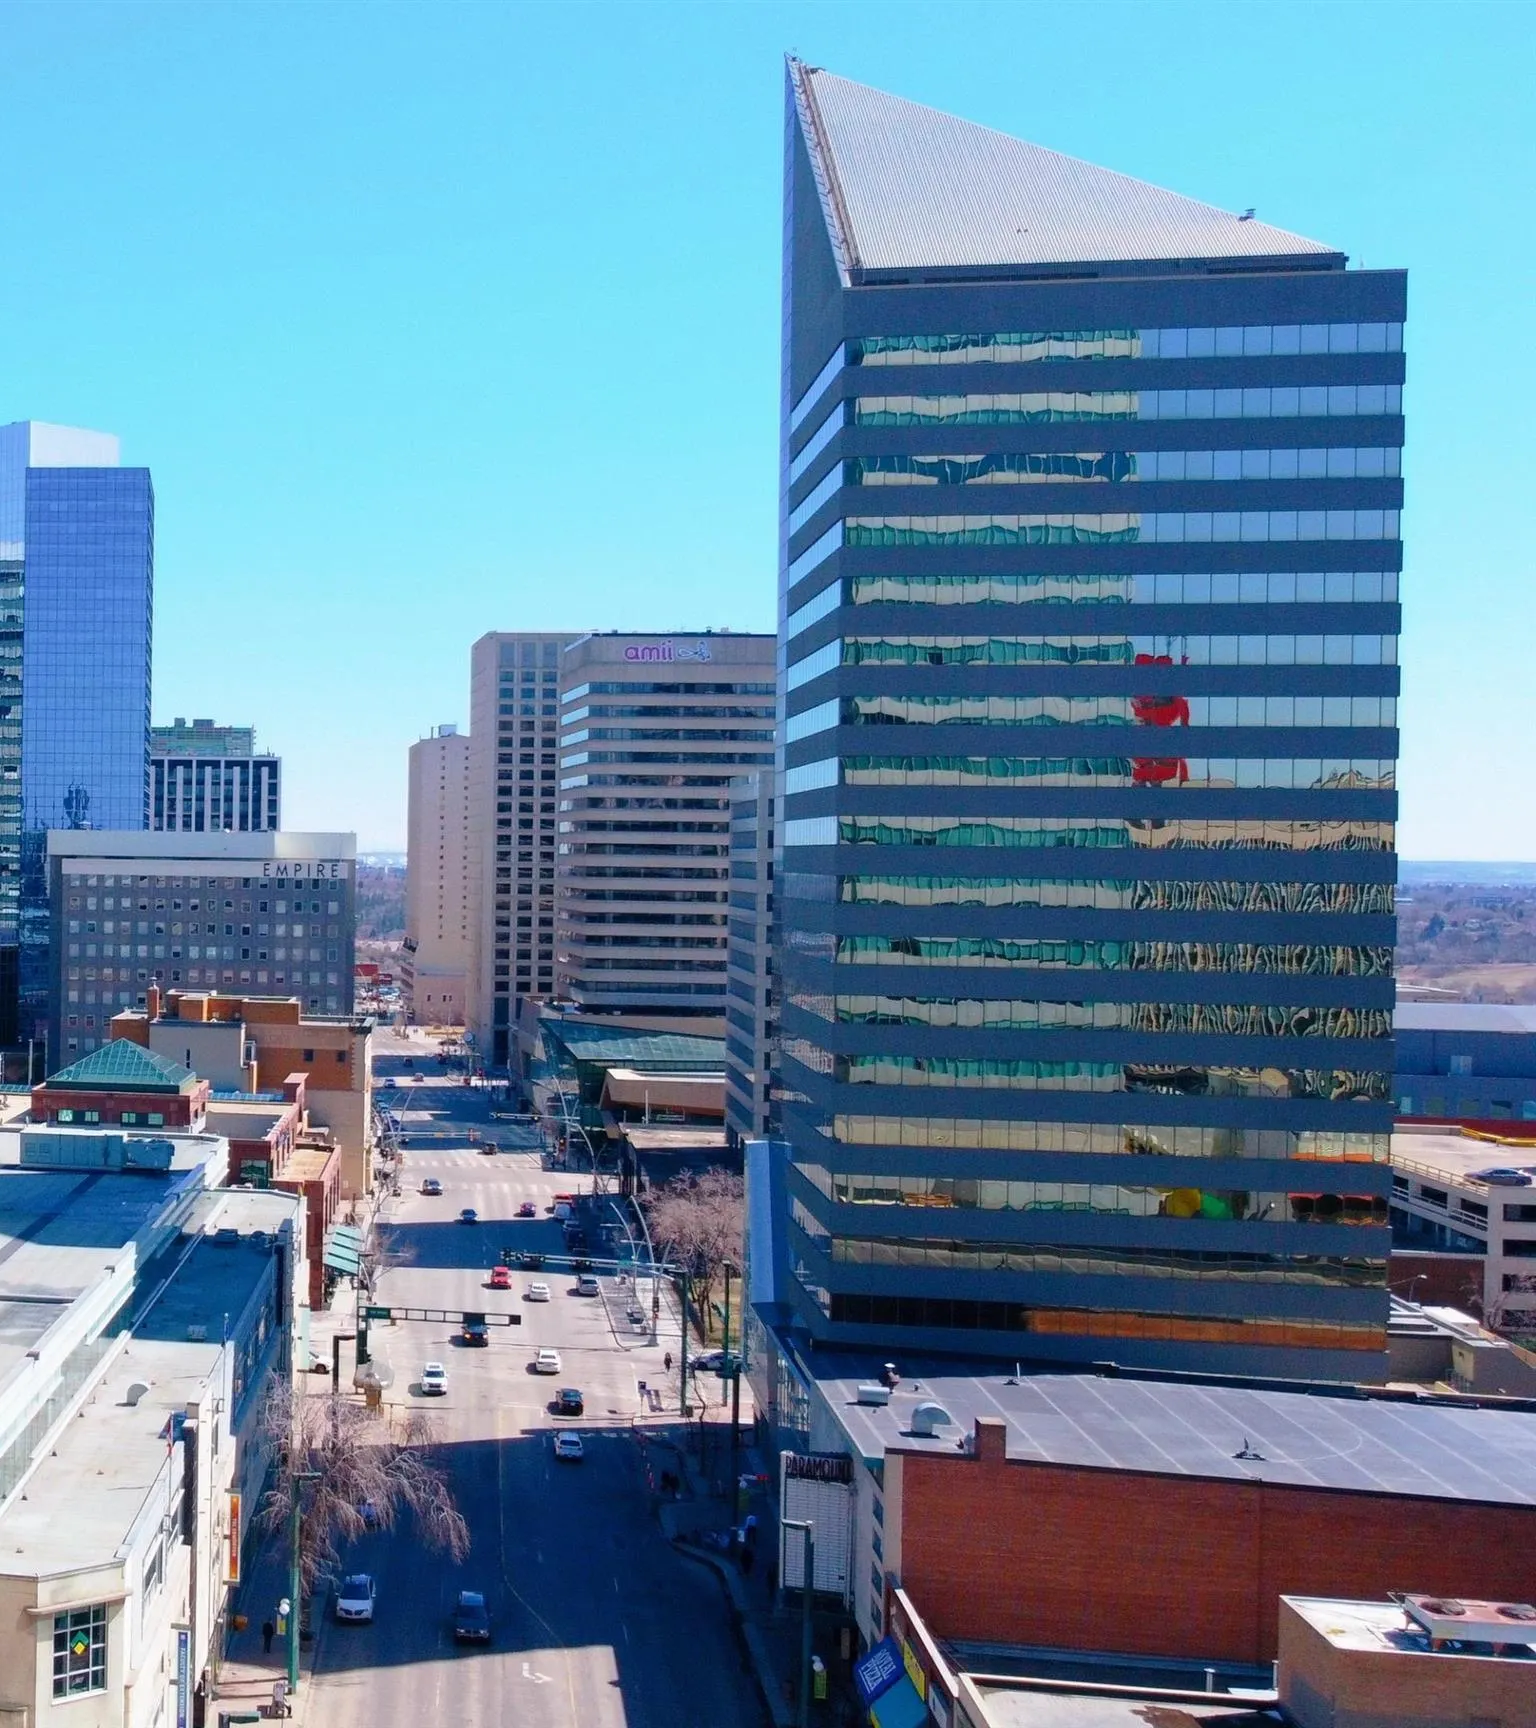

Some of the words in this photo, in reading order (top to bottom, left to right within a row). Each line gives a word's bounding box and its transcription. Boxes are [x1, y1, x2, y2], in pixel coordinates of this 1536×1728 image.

[625, 640, 672, 660] amii
[263, 863, 338, 877] EMPIRE
[861, 1658, 883, 1691] PIZZA
[873, 1648, 897, 1681] ROYAL
